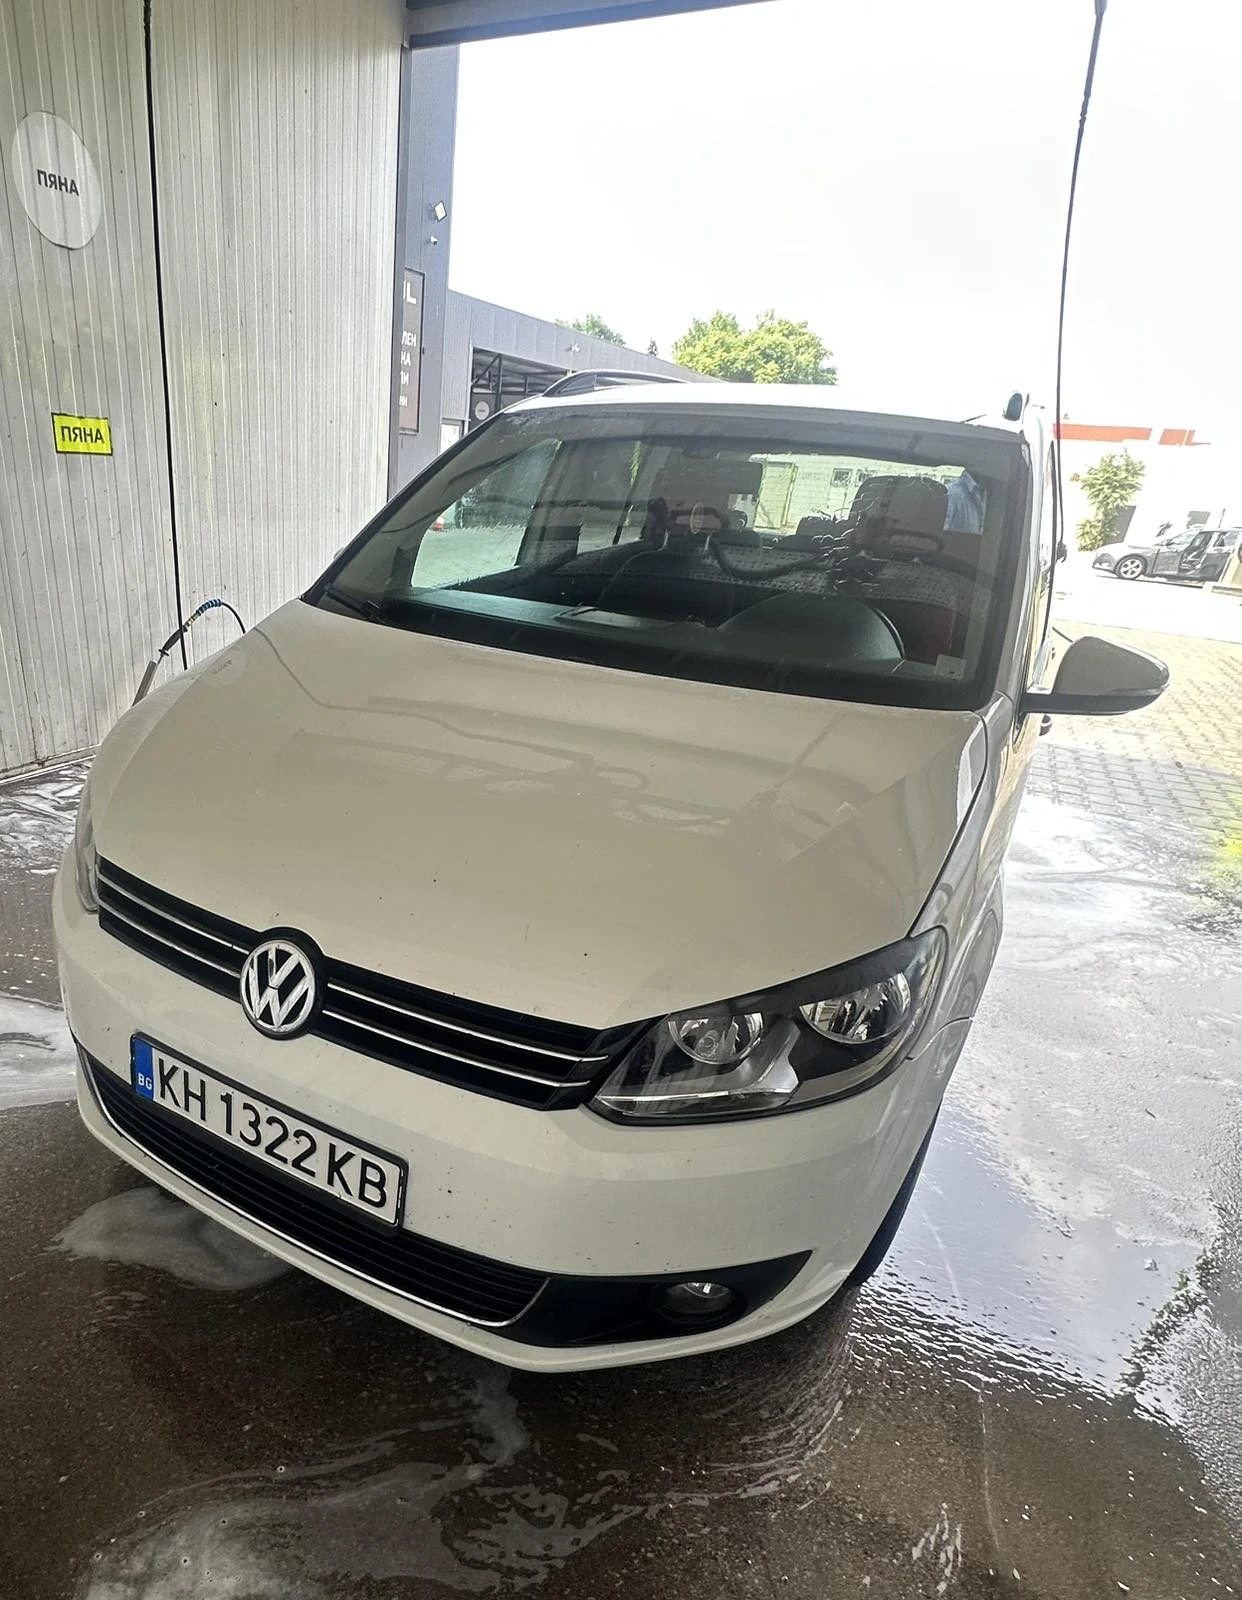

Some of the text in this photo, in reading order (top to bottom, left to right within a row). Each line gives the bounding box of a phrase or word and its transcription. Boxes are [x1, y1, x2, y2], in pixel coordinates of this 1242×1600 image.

[37, 169, 80, 196] ПЯНА
[60, 425, 105, 444] ПЯНА
[138, 1072, 153, 1090] BG
